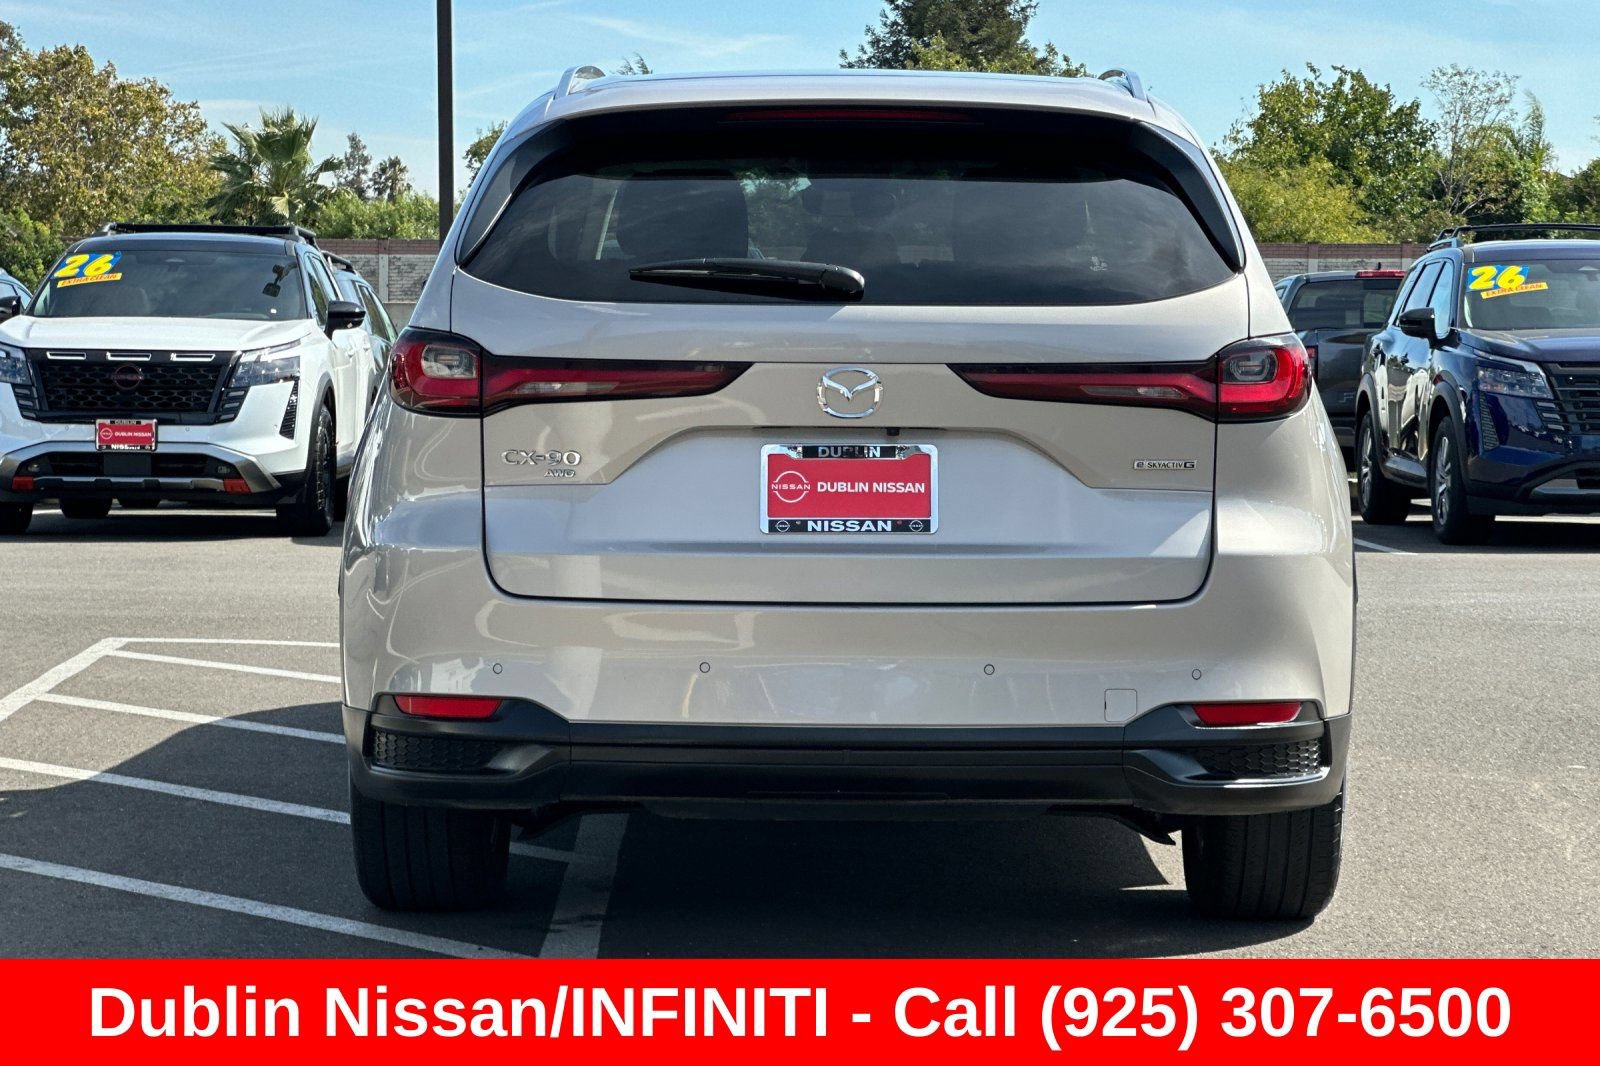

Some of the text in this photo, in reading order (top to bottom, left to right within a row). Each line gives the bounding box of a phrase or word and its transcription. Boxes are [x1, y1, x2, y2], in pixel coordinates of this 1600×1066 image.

[54, 254, 114, 277] 26
[1468, 265, 1525, 289] 26
[501, 449, 581, 466] CX-90
[544, 468, 576, 478] AWD
[817, 482, 925, 493] DUBLIN NISSAN
[807, 520, 892, 532] NISSAN
